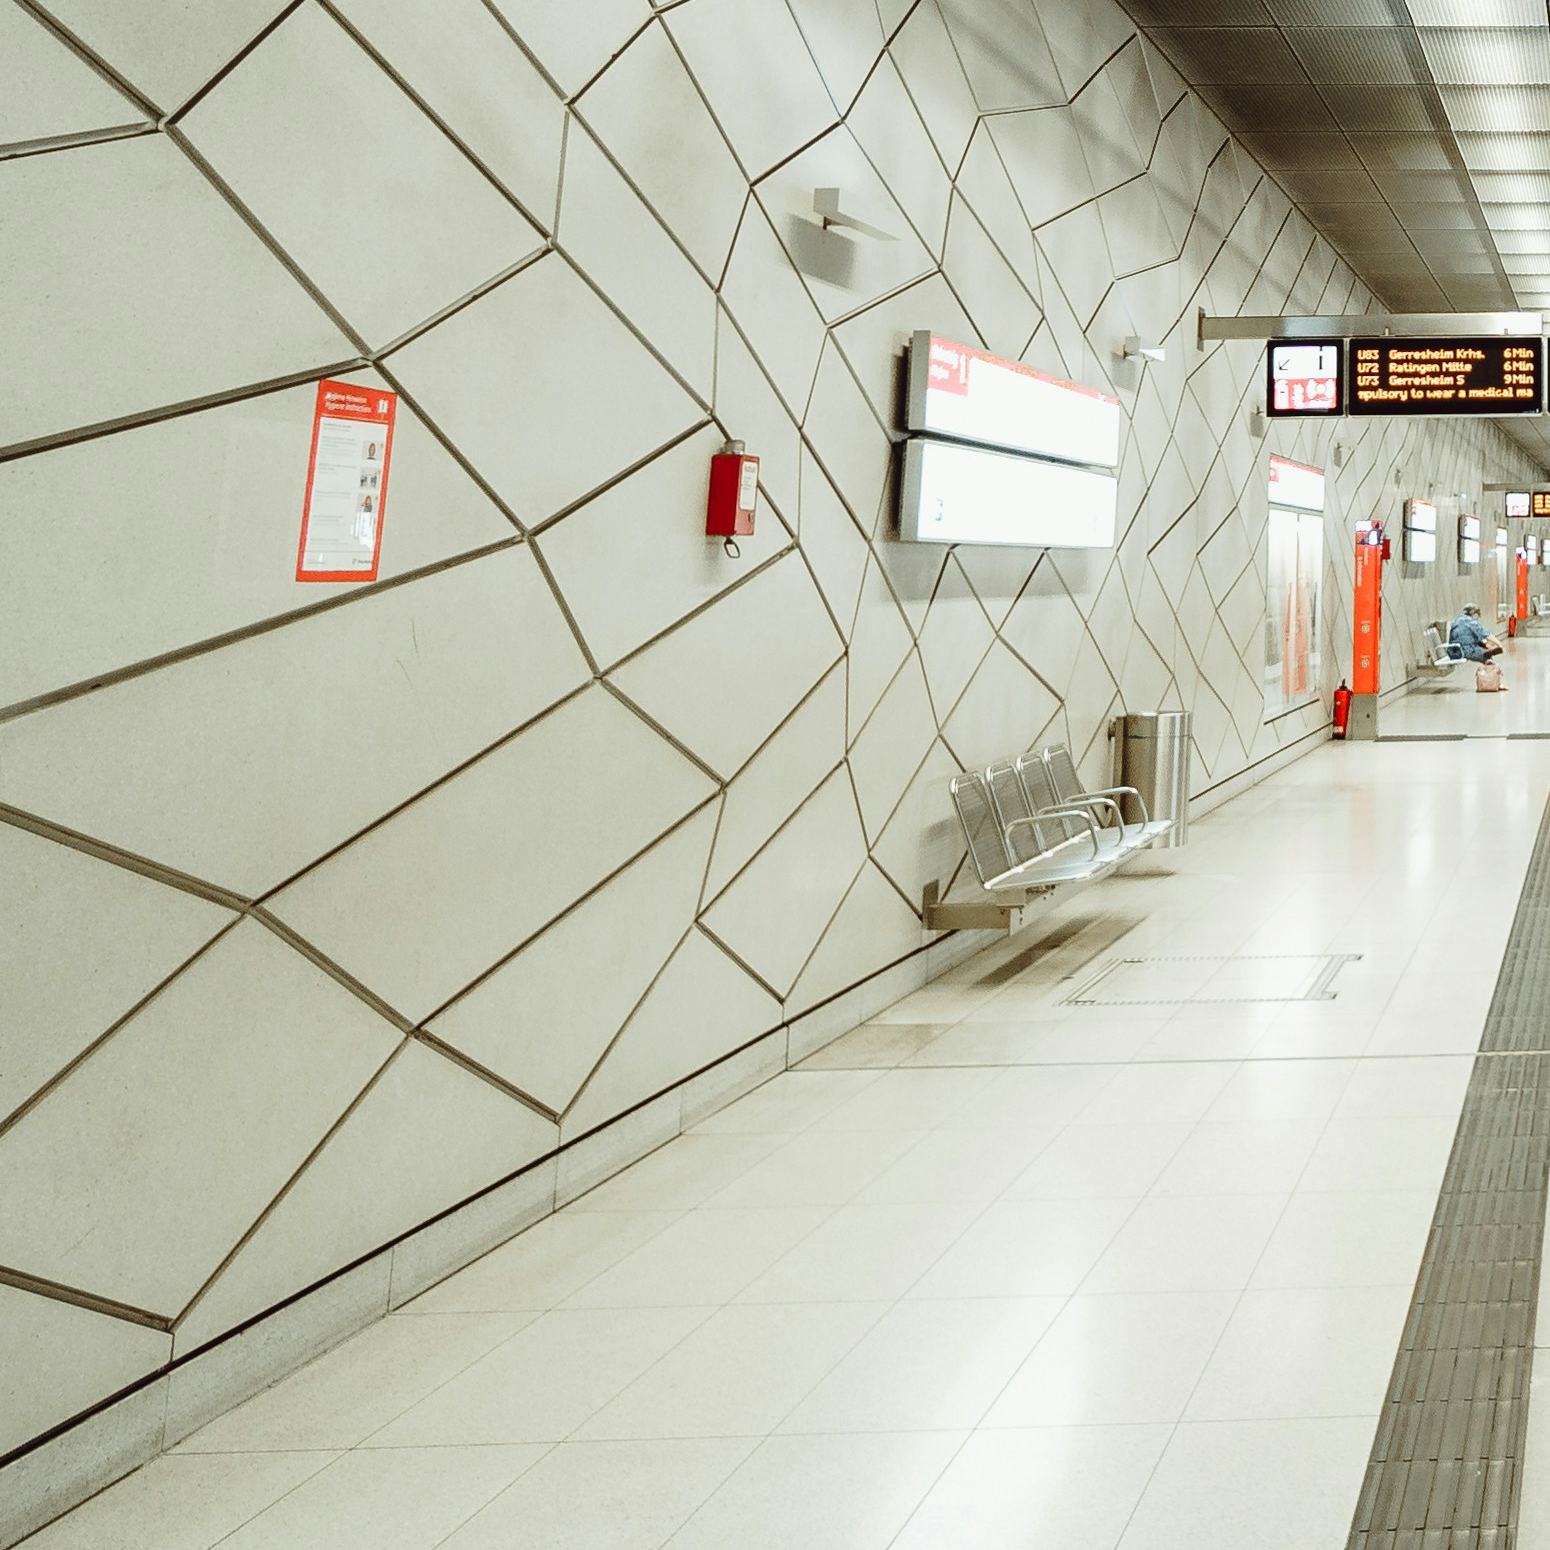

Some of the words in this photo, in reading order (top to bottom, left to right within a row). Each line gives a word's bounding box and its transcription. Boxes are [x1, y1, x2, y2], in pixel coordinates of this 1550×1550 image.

[1357, 349, 1380, 360] U83
[1388, 349, 1454, 360] Gerresheim
[1455, 348, 1486, 359] Krhs.
[1357, 362, 1380, 373] U72
[1388, 362, 1441, 375] Ratingen
[1441, 361, 1472, 373] Mitte
[1357, 375, 1380, 386] U73
[1388, 375, 1454, 386] Gerresheim
[1456, 375, 1466, 385] S
[1410, 388, 1424, 399] to
[1426, 390, 1456, 399] wear
[1457, 390, 1467, 399] a
[1468, 388, 1515, 399] medical
